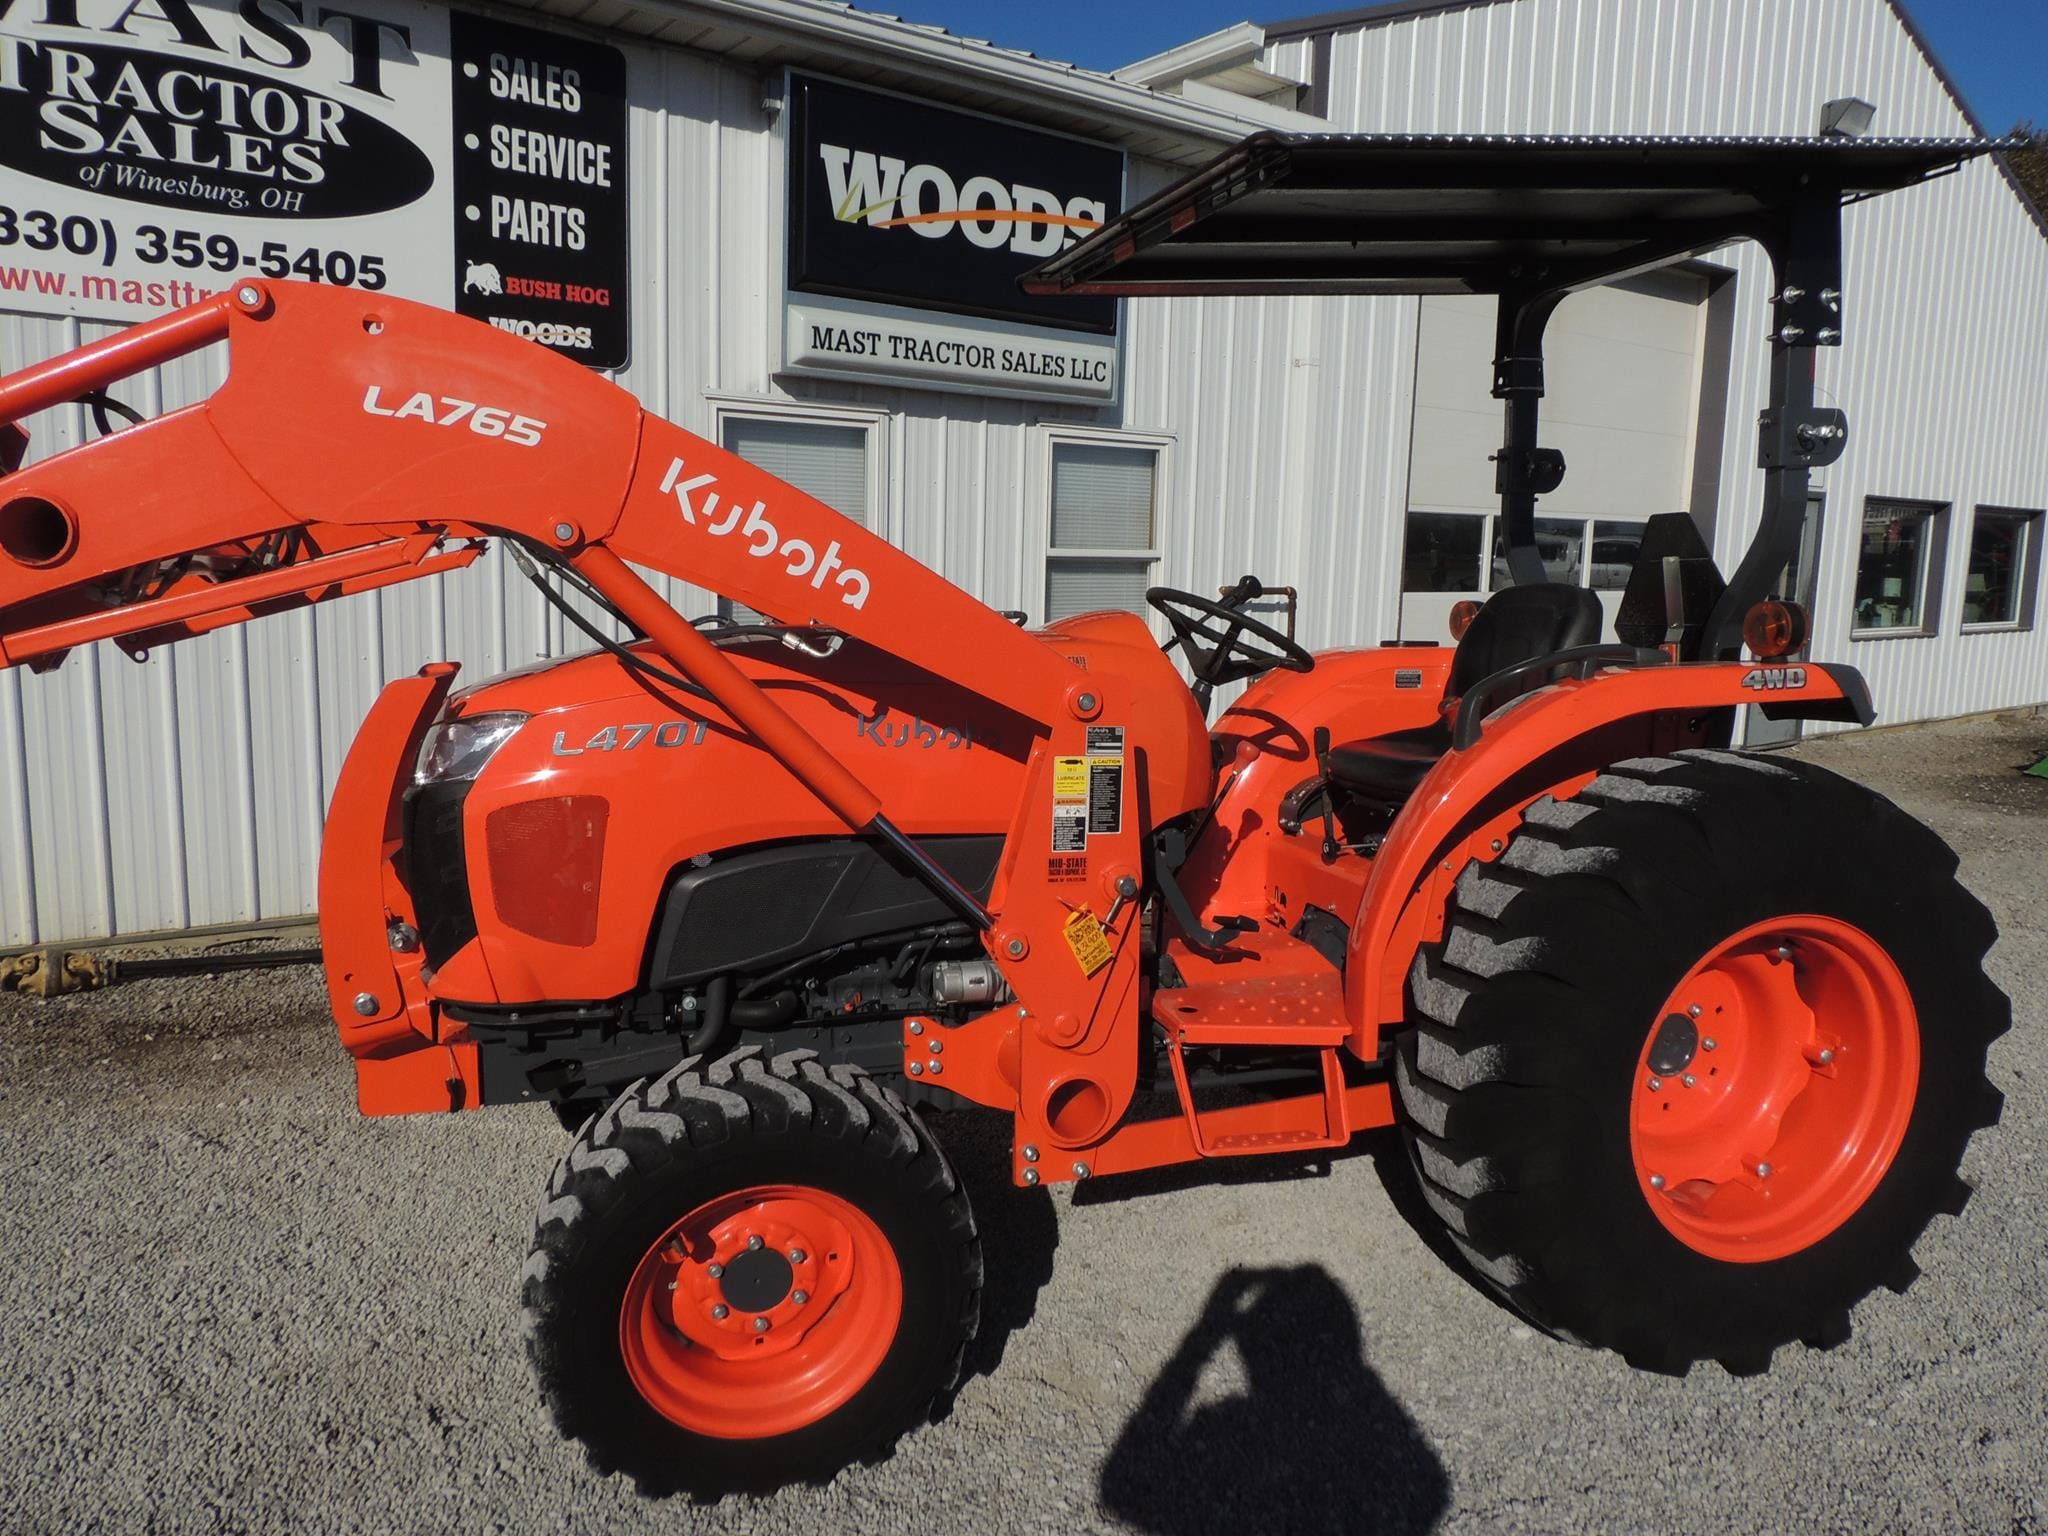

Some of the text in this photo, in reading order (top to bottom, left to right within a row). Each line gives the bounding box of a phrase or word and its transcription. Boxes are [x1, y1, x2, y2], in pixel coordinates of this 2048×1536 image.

[0, 34, 350, 147] TRACTOR
[489, 52, 582, 113] SALES
[40, 100, 326, 184] SALES
[489, 123, 612, 188] SERVICE
[79, 161, 305, 212] of Winesburg, OH
[819, 142, 1106, 258] WOODS
[491, 194, 586, 251] PARTS
[134, 224, 387, 291] 359-5405
[505, 276, 610, 307] BUSH HOG
[489, 316, 593, 349] WOODS
[811, 325, 1107, 383] MAST TRACTOR SALES LLC
[362, 385, 547, 447] LA765
[659, 456, 870, 610] Kubota
[1741, 667, 1807, 690] 4WD
[553, 720, 708, 757] L4701
